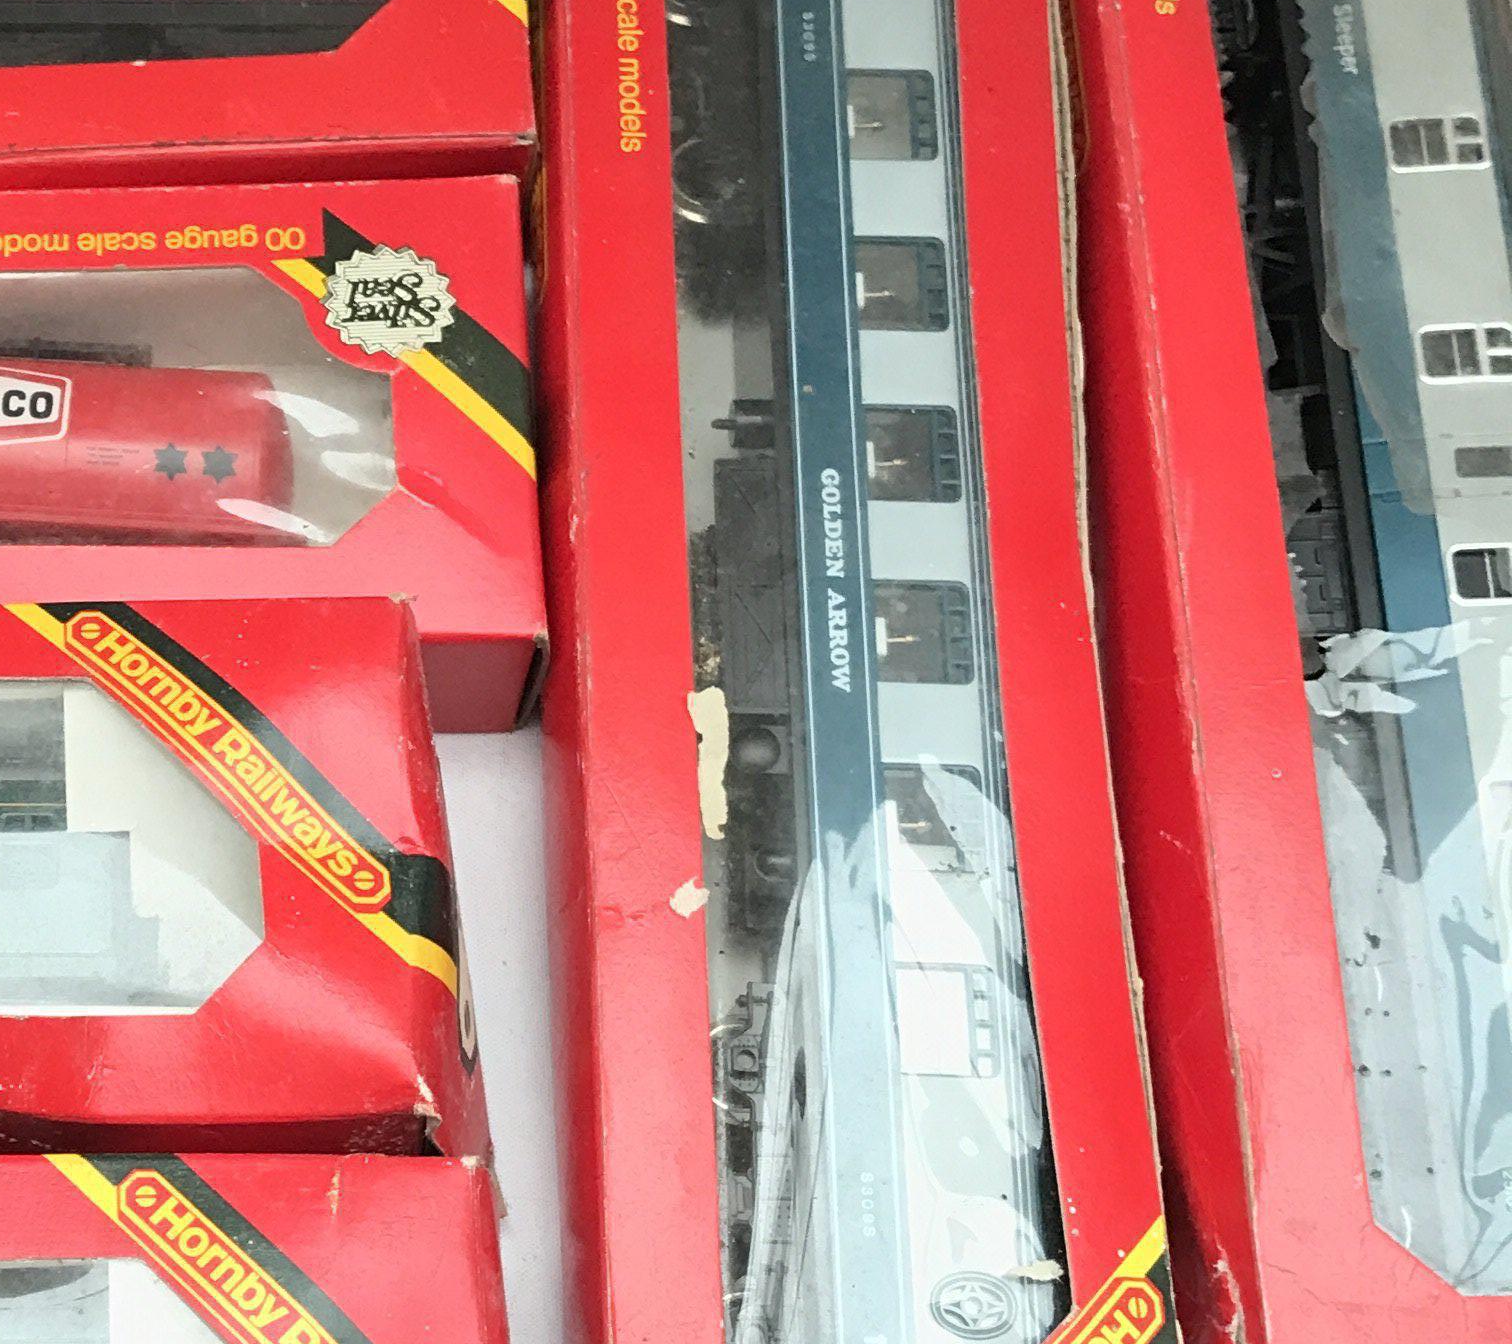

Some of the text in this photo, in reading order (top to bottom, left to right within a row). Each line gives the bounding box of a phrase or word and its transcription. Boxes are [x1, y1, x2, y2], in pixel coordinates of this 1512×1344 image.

[1330, 1, 1360, 76] Sleeper
[619, 57, 648, 155] models
[76, 229, 156, 256] scale
[164, 223, 258, 253] gauge
[346, 271, 425, 305] Seal
[347, 293, 442, 332] Silver
[819, 467, 852, 693] GOLDEN ARROW
[93, 629, 359, 877] Hornby Railways
[149, 1196, 290, 1329] Hornby
